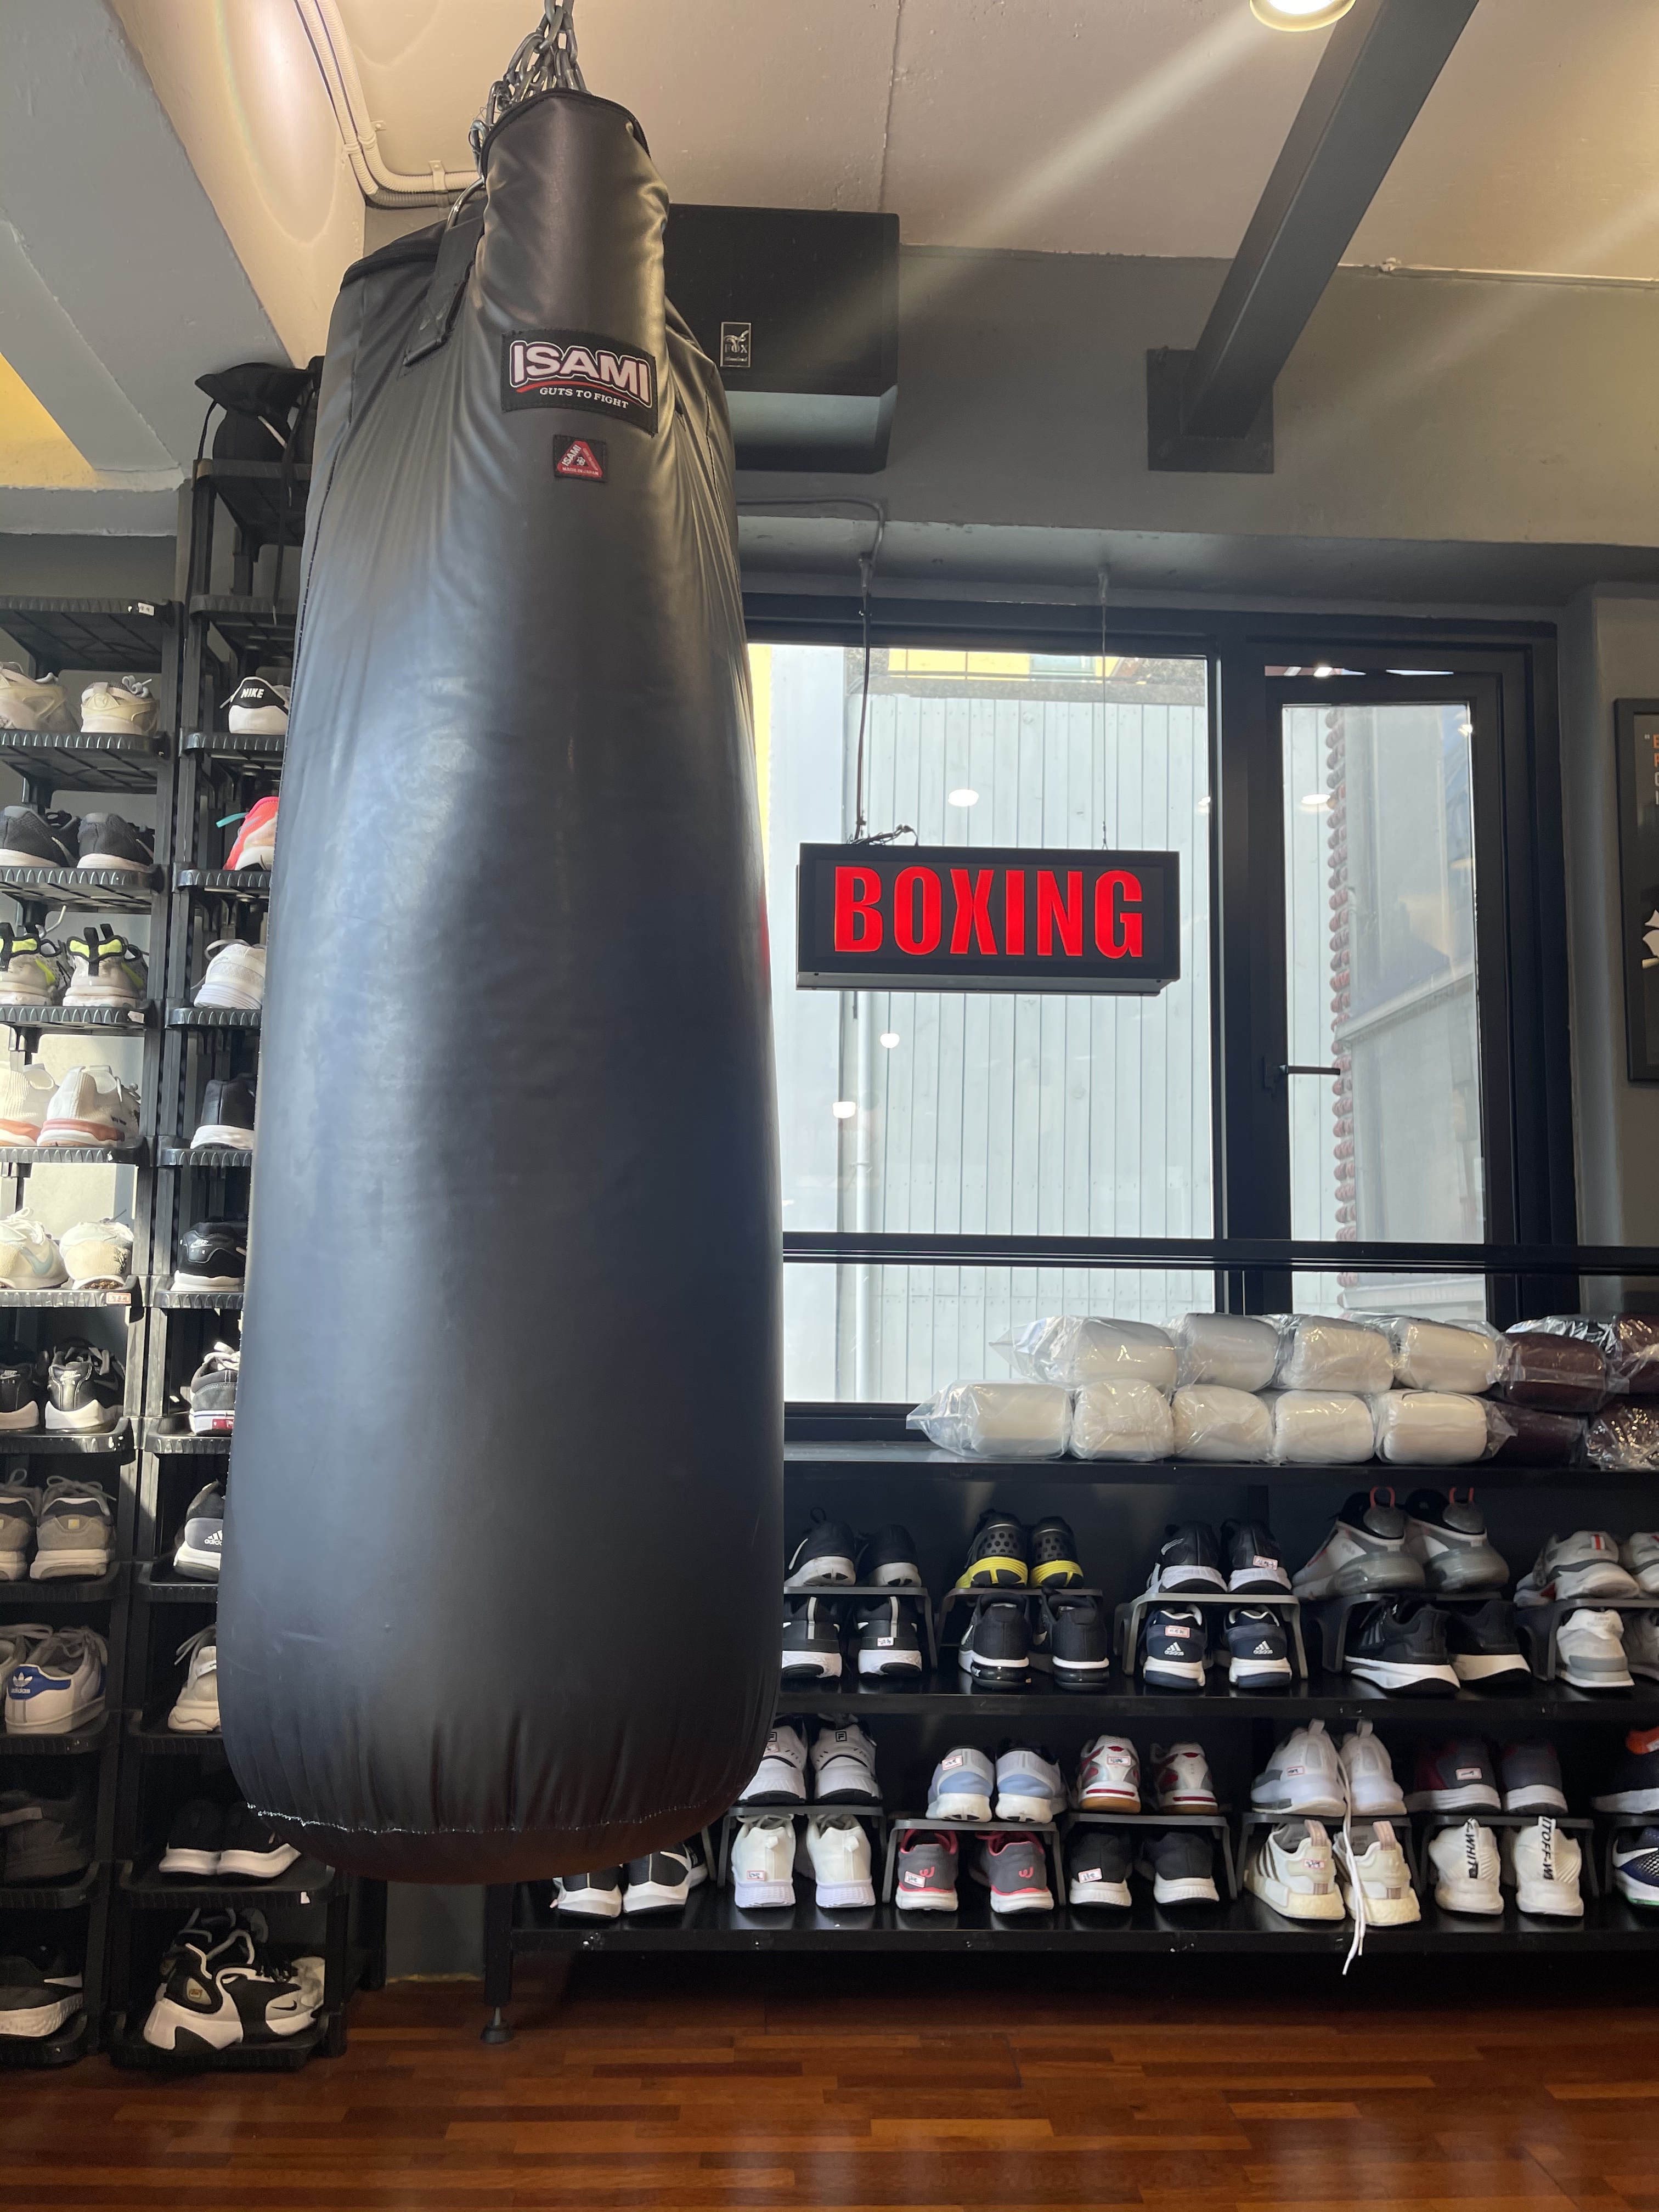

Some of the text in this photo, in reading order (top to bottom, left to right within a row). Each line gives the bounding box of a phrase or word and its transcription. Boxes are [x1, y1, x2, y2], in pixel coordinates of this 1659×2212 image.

[512, 344, 651, 404] ISAMI
[539, 387, 629, 409] GUTS TO FIGHT
[561, 444, 582, 466] ISAMI
[240, 687, 264, 698] NIKE
[834, 866, 1143, 960] BOXING
